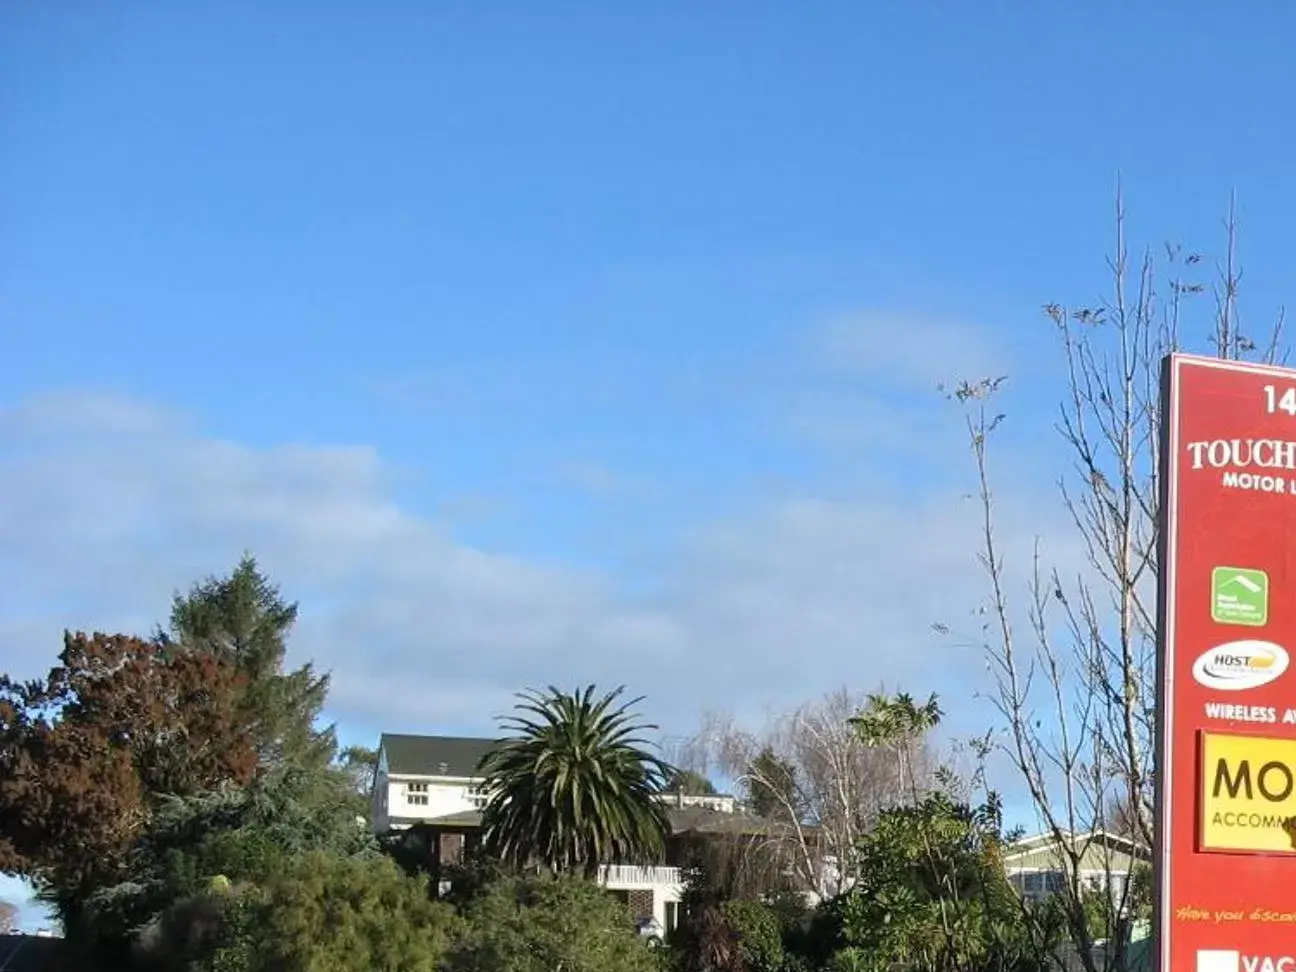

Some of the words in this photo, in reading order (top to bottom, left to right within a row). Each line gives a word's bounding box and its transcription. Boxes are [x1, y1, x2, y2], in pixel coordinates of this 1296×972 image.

[1223, 472, 1284, 493] MOTOR
[1214, 654, 1252, 667] HOST
[1205, 702, 1276, 723] WIRELESS
[1215, 909, 1245, 924] you
